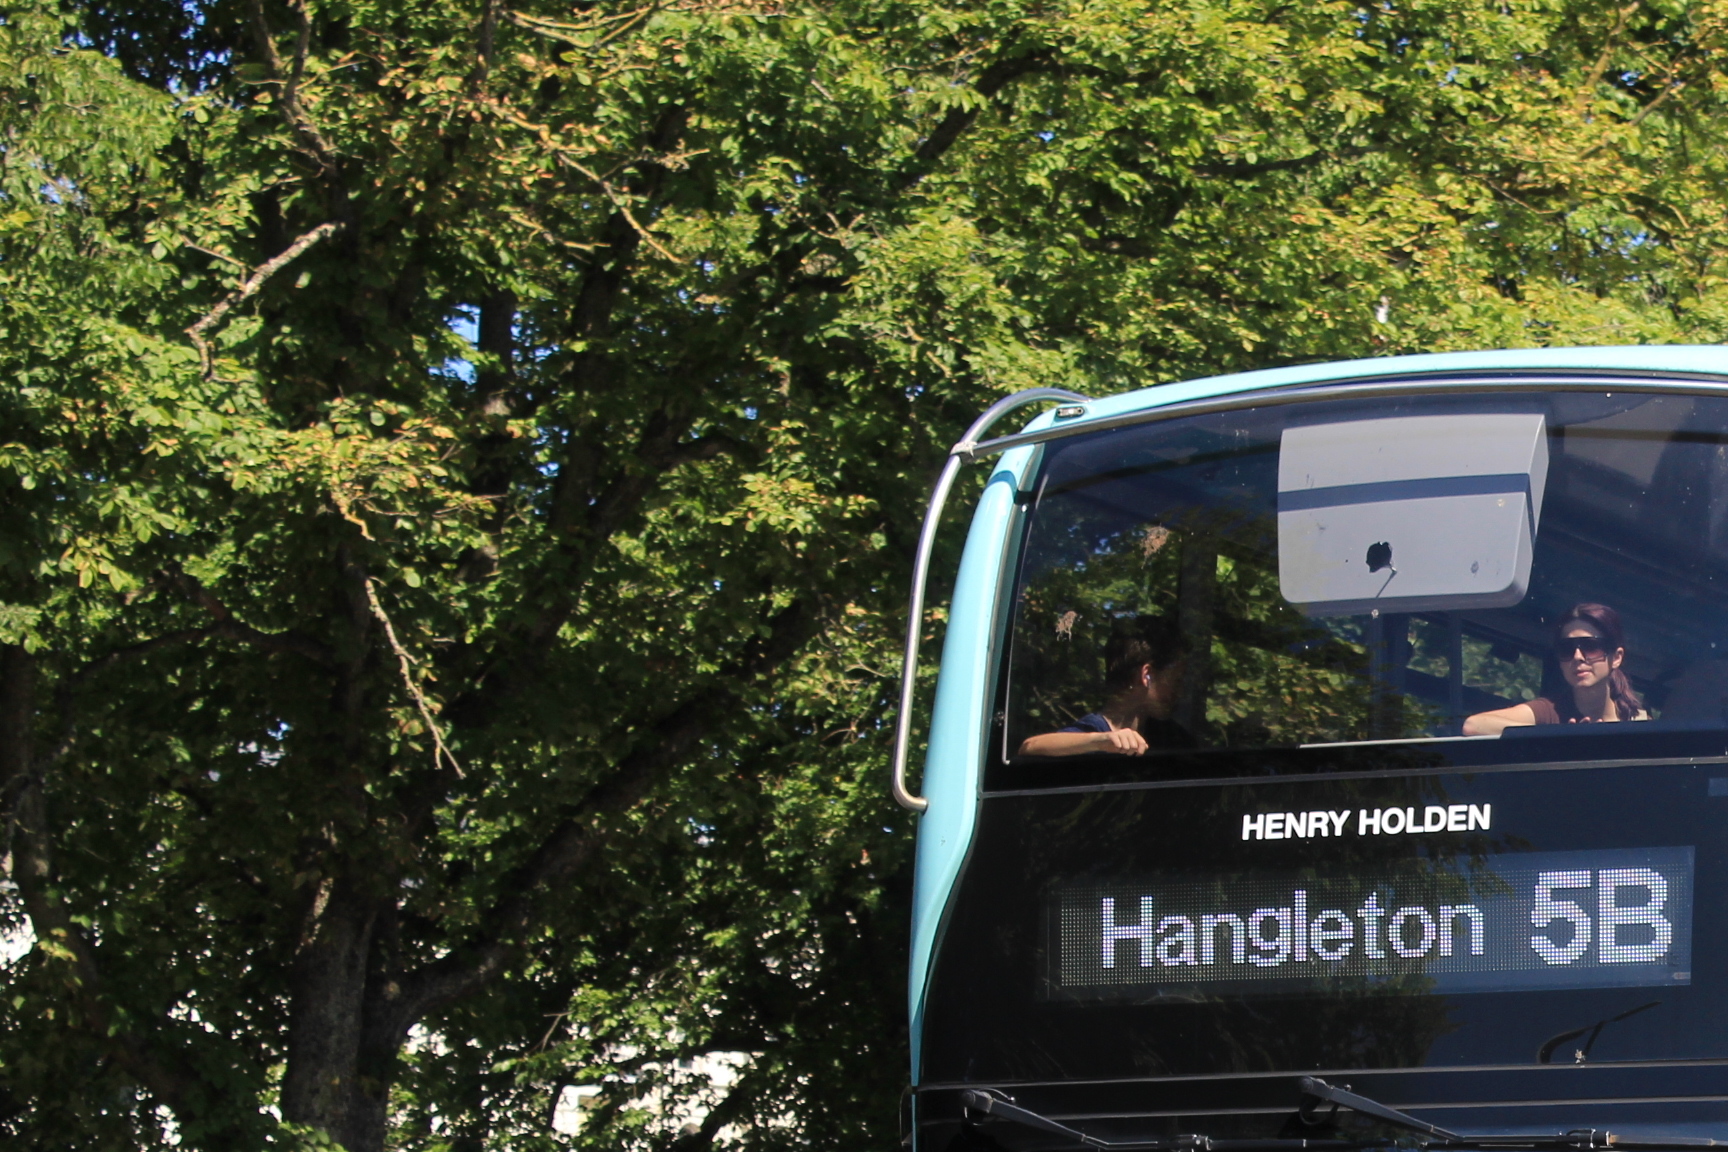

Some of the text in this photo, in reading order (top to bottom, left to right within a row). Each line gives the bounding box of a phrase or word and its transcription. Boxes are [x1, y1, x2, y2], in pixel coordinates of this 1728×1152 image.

[1241, 803, 1492, 841] HENRY HOLDEN
[1102, 867, 1673, 969] Hangleton 5B
